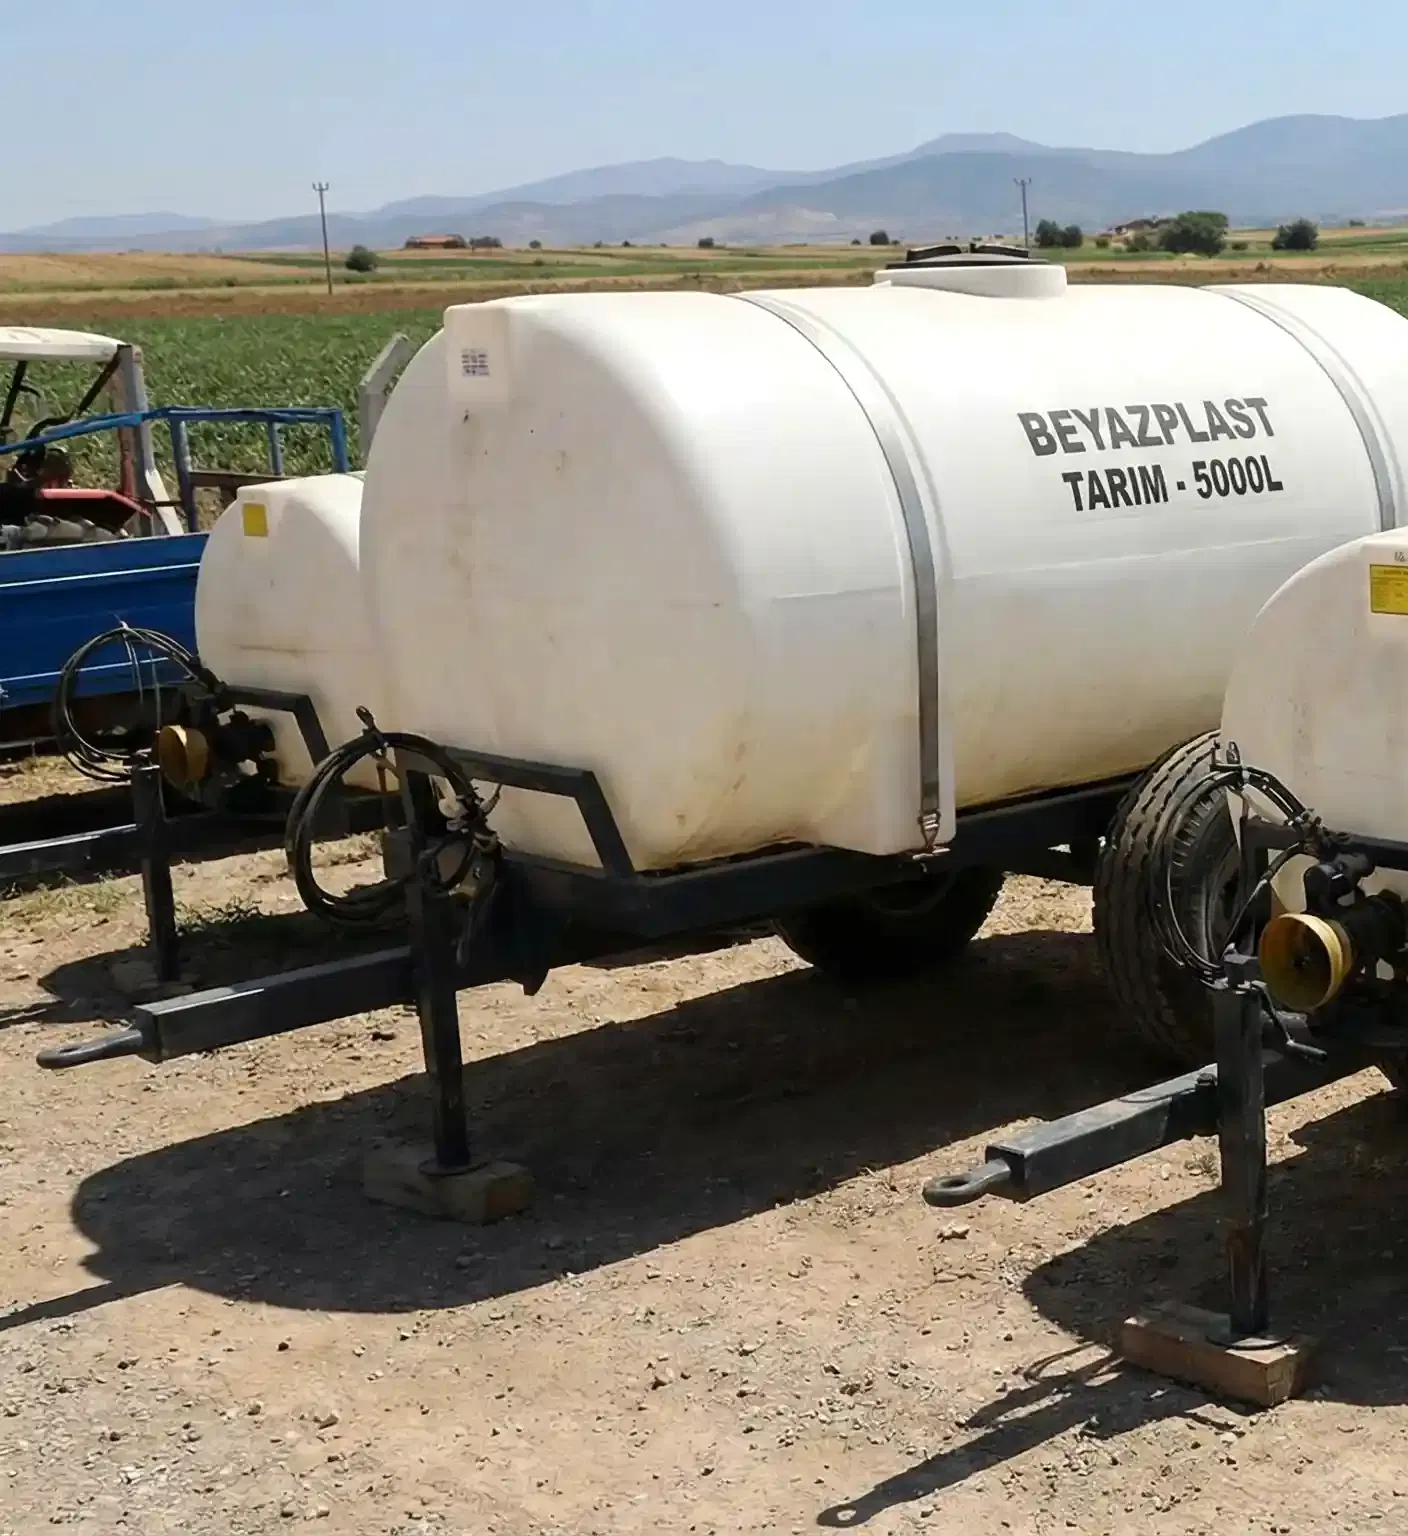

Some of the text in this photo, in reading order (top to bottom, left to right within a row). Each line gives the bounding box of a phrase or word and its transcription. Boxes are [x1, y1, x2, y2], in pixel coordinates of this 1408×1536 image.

[1016, 397, 1275, 457] BEYAZPLAST
[1061, 463, 1170, 512] TARIM
[1191, 454, 1284, 500] 5000L
